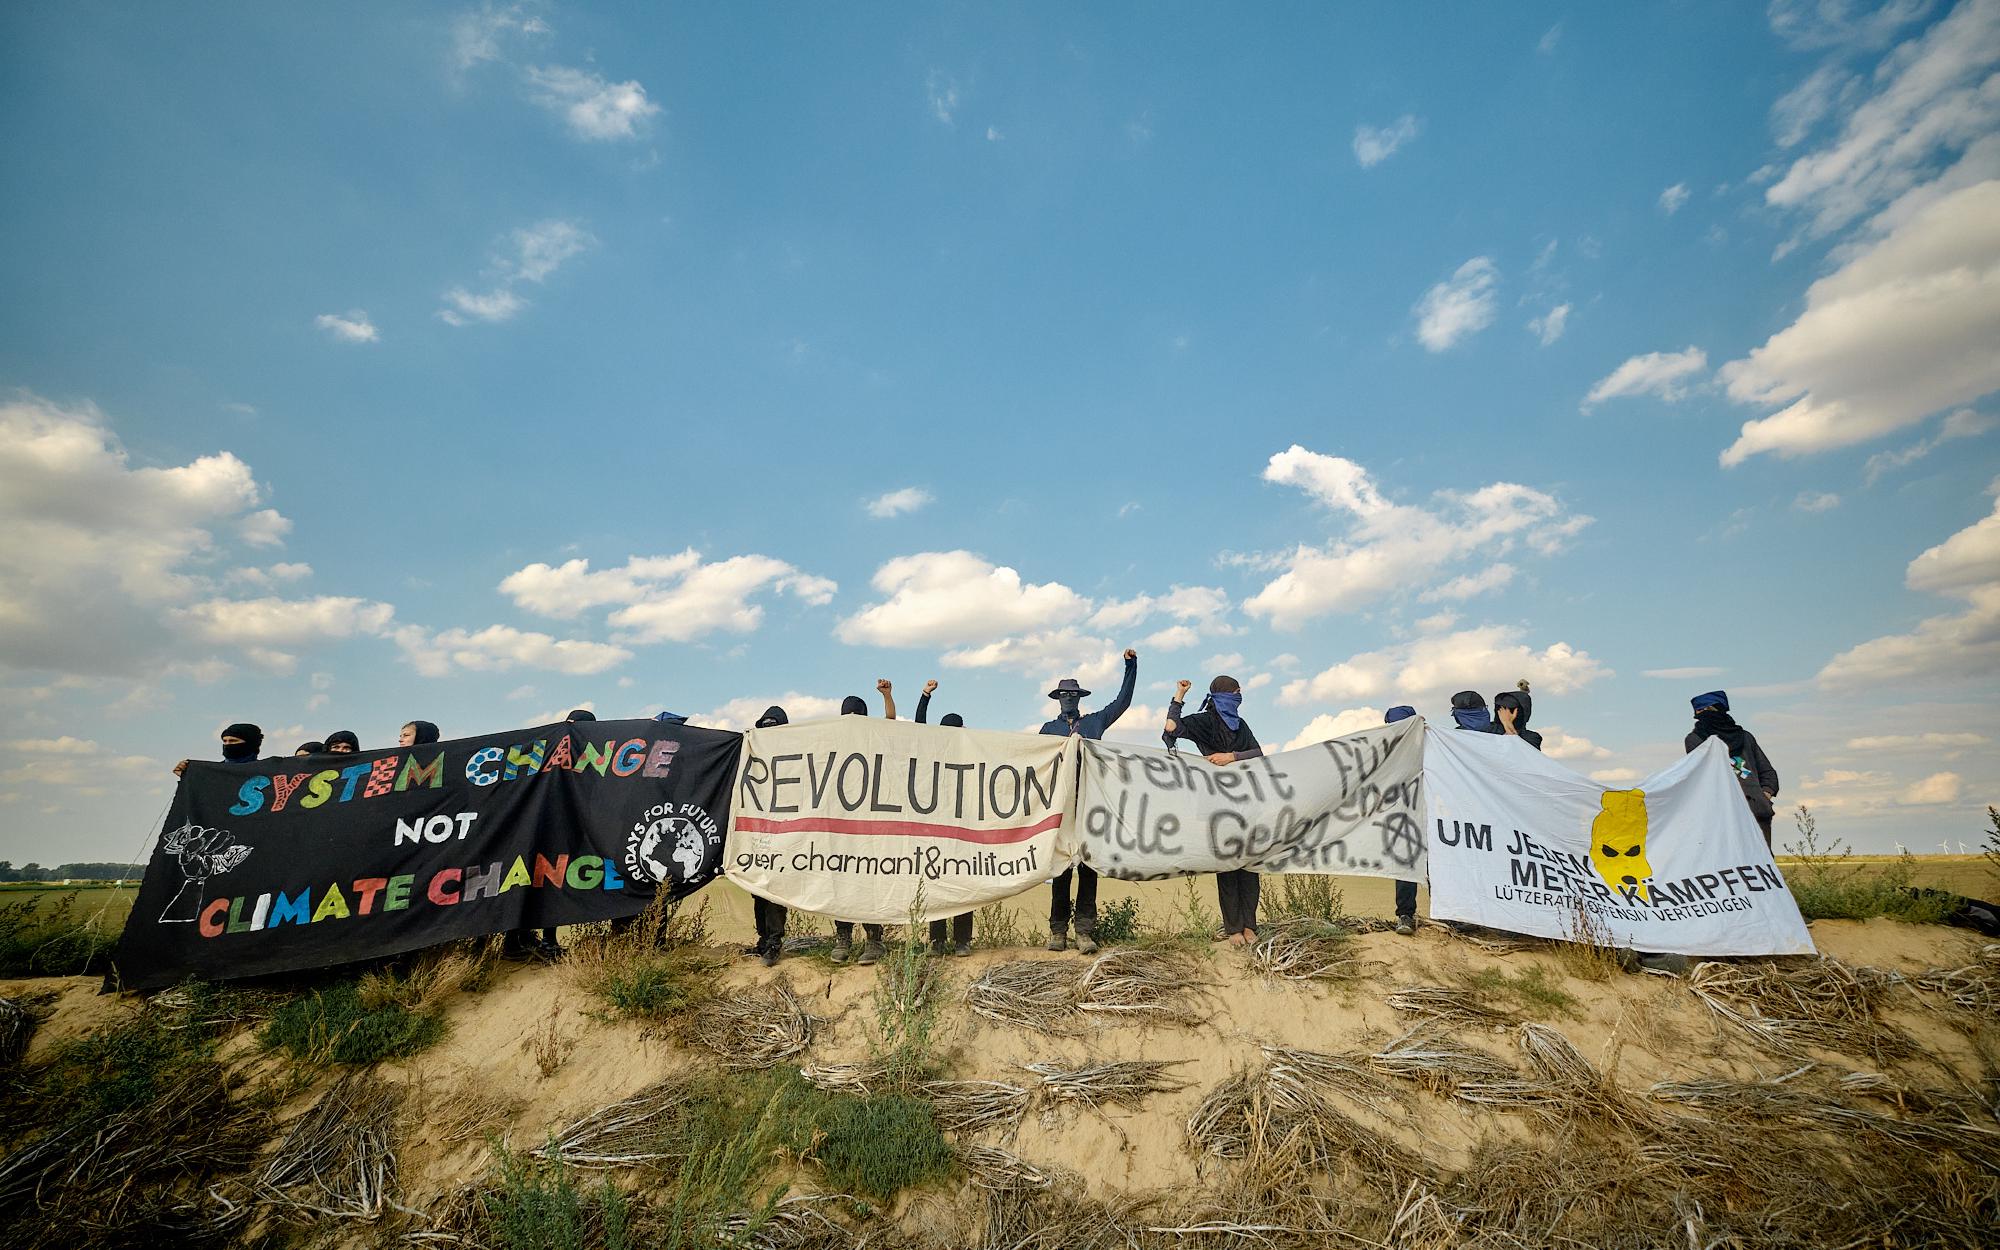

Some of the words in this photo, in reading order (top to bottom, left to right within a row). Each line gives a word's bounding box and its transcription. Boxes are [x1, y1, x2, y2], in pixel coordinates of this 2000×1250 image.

[229, 751, 445, 816] SYSTEM
[466, 735, 681, 786] CHANGE
[740, 751, 1063, 821] REVOLUTION
[394, 812, 478, 846] NOT
[624, 822, 649, 883] RIDAYS
[643, 802, 673, 822] FOR
[679, 803, 720, 845] FUTURE
[1085, 789, 1184, 855] alle
[1437, 818, 1493, 852] UM
[1506, 829, 1597, 878] JEDEN
[199, 874, 415, 938] CLIMATE
[427, 853, 624, 906] CHANGE
[1510, 858, 1619, 907] METER
[1617, 863, 1783, 908] KÄMPFEN
[1651, 896, 1753, 922] VERTEIDIGEN
